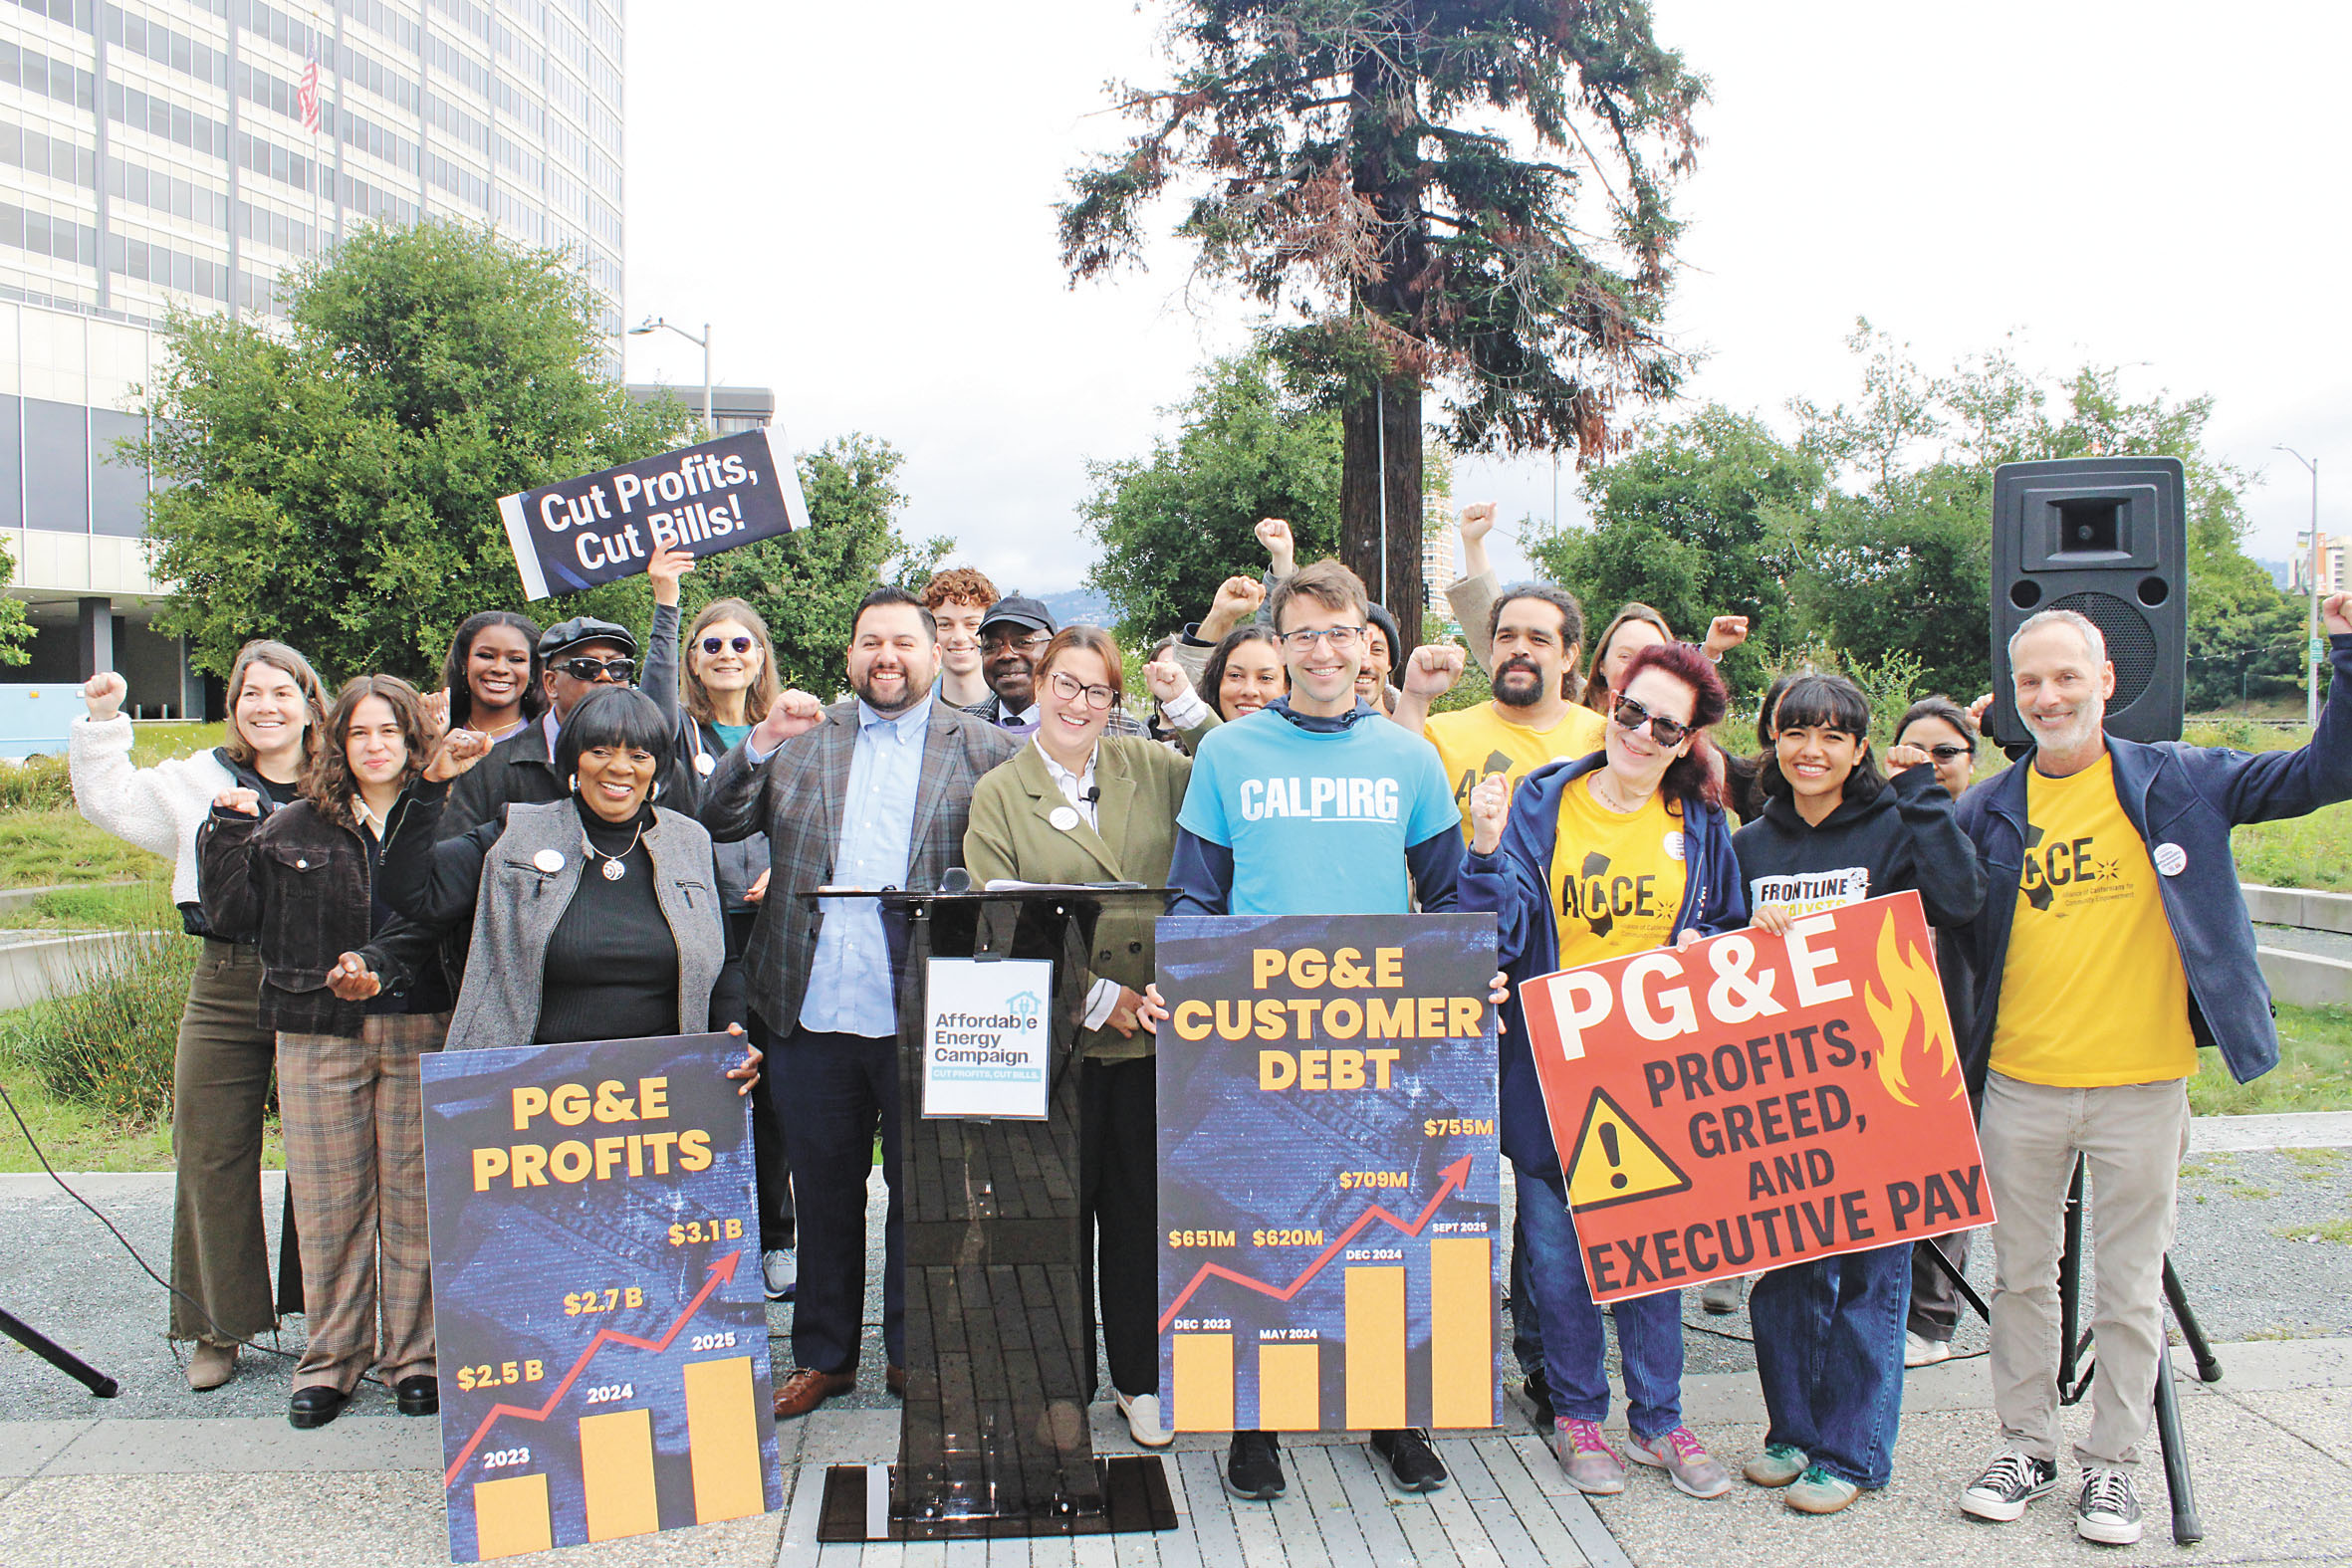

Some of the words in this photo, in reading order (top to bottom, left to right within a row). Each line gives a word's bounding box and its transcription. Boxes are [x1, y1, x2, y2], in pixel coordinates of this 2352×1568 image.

[540, 485, 612, 532] Cut
[613, 454, 759, 514] Profits,
[576, 524, 645, 570] Cut
[647, 494, 746, 550] Bills!
[1240, 777, 1399, 822] CALPIRG
[1561, 875, 1656, 920] ACCE
[1761, 878, 1848, 902] FRONTLINE
[1253, 947, 1404, 990] PG&E
[1546, 913, 1853, 1061] PG&E
[1173, 997, 1484, 1041] CUSTOMER
[935, 1030, 1002, 1048] Energy
[934, 1047, 1029, 1066] Campaign
[1259, 1048, 1401, 1091] DEBT
[1643, 1018, 1872, 1108] PROFITS,
[933, 1069, 953, 1078] CUT
[953, 1070, 993, 1080] PROFITS,
[994, 1071, 1013, 1080] CUT
[512, 1076, 670, 1131] PG&E
[1423, 1118, 1495, 1137] $755M
[1688, 1084, 1868, 1159] GREED,
[472, 1129, 713, 1193] PROFITS
[1748, 1148, 1835, 1201] AND
[1339, 1171, 1409, 1190] $709M
[668, 1220, 719, 1247] $3.1
[725, 1219, 744, 1239] B
[1168, 1230, 1237, 1248] $651M
[1252, 1230, 1324, 1248] $620M
[1432, 1224, 1459, 1233] SEPT
[1460, 1223, 1489, 1233] 2025
[1587, 1190, 1875, 1293] EXECUTIVE
[1886, 1165, 1983, 1232] PAY
[1345, 1250, 1371, 1261] DEC
[1372, 1249, 1403, 1261] 2024
[564, 1288, 619, 1317] $2.7
[624, 1286, 643, 1309] B
[1174, 1319, 1199, 1331] DEC
[1202, 1319, 1233, 1331] 2023
[1260, 1330, 1288, 1341] MAY
[1289, 1329, 1318, 1341] 2024
[691, 1332, 737, 1351] 2025
[456, 1361, 519, 1392] $2.5
[524, 1359, 545, 1382] B
[587, 1383, 634, 1404] 2024
[483, 1448, 531, 1468] 2023
